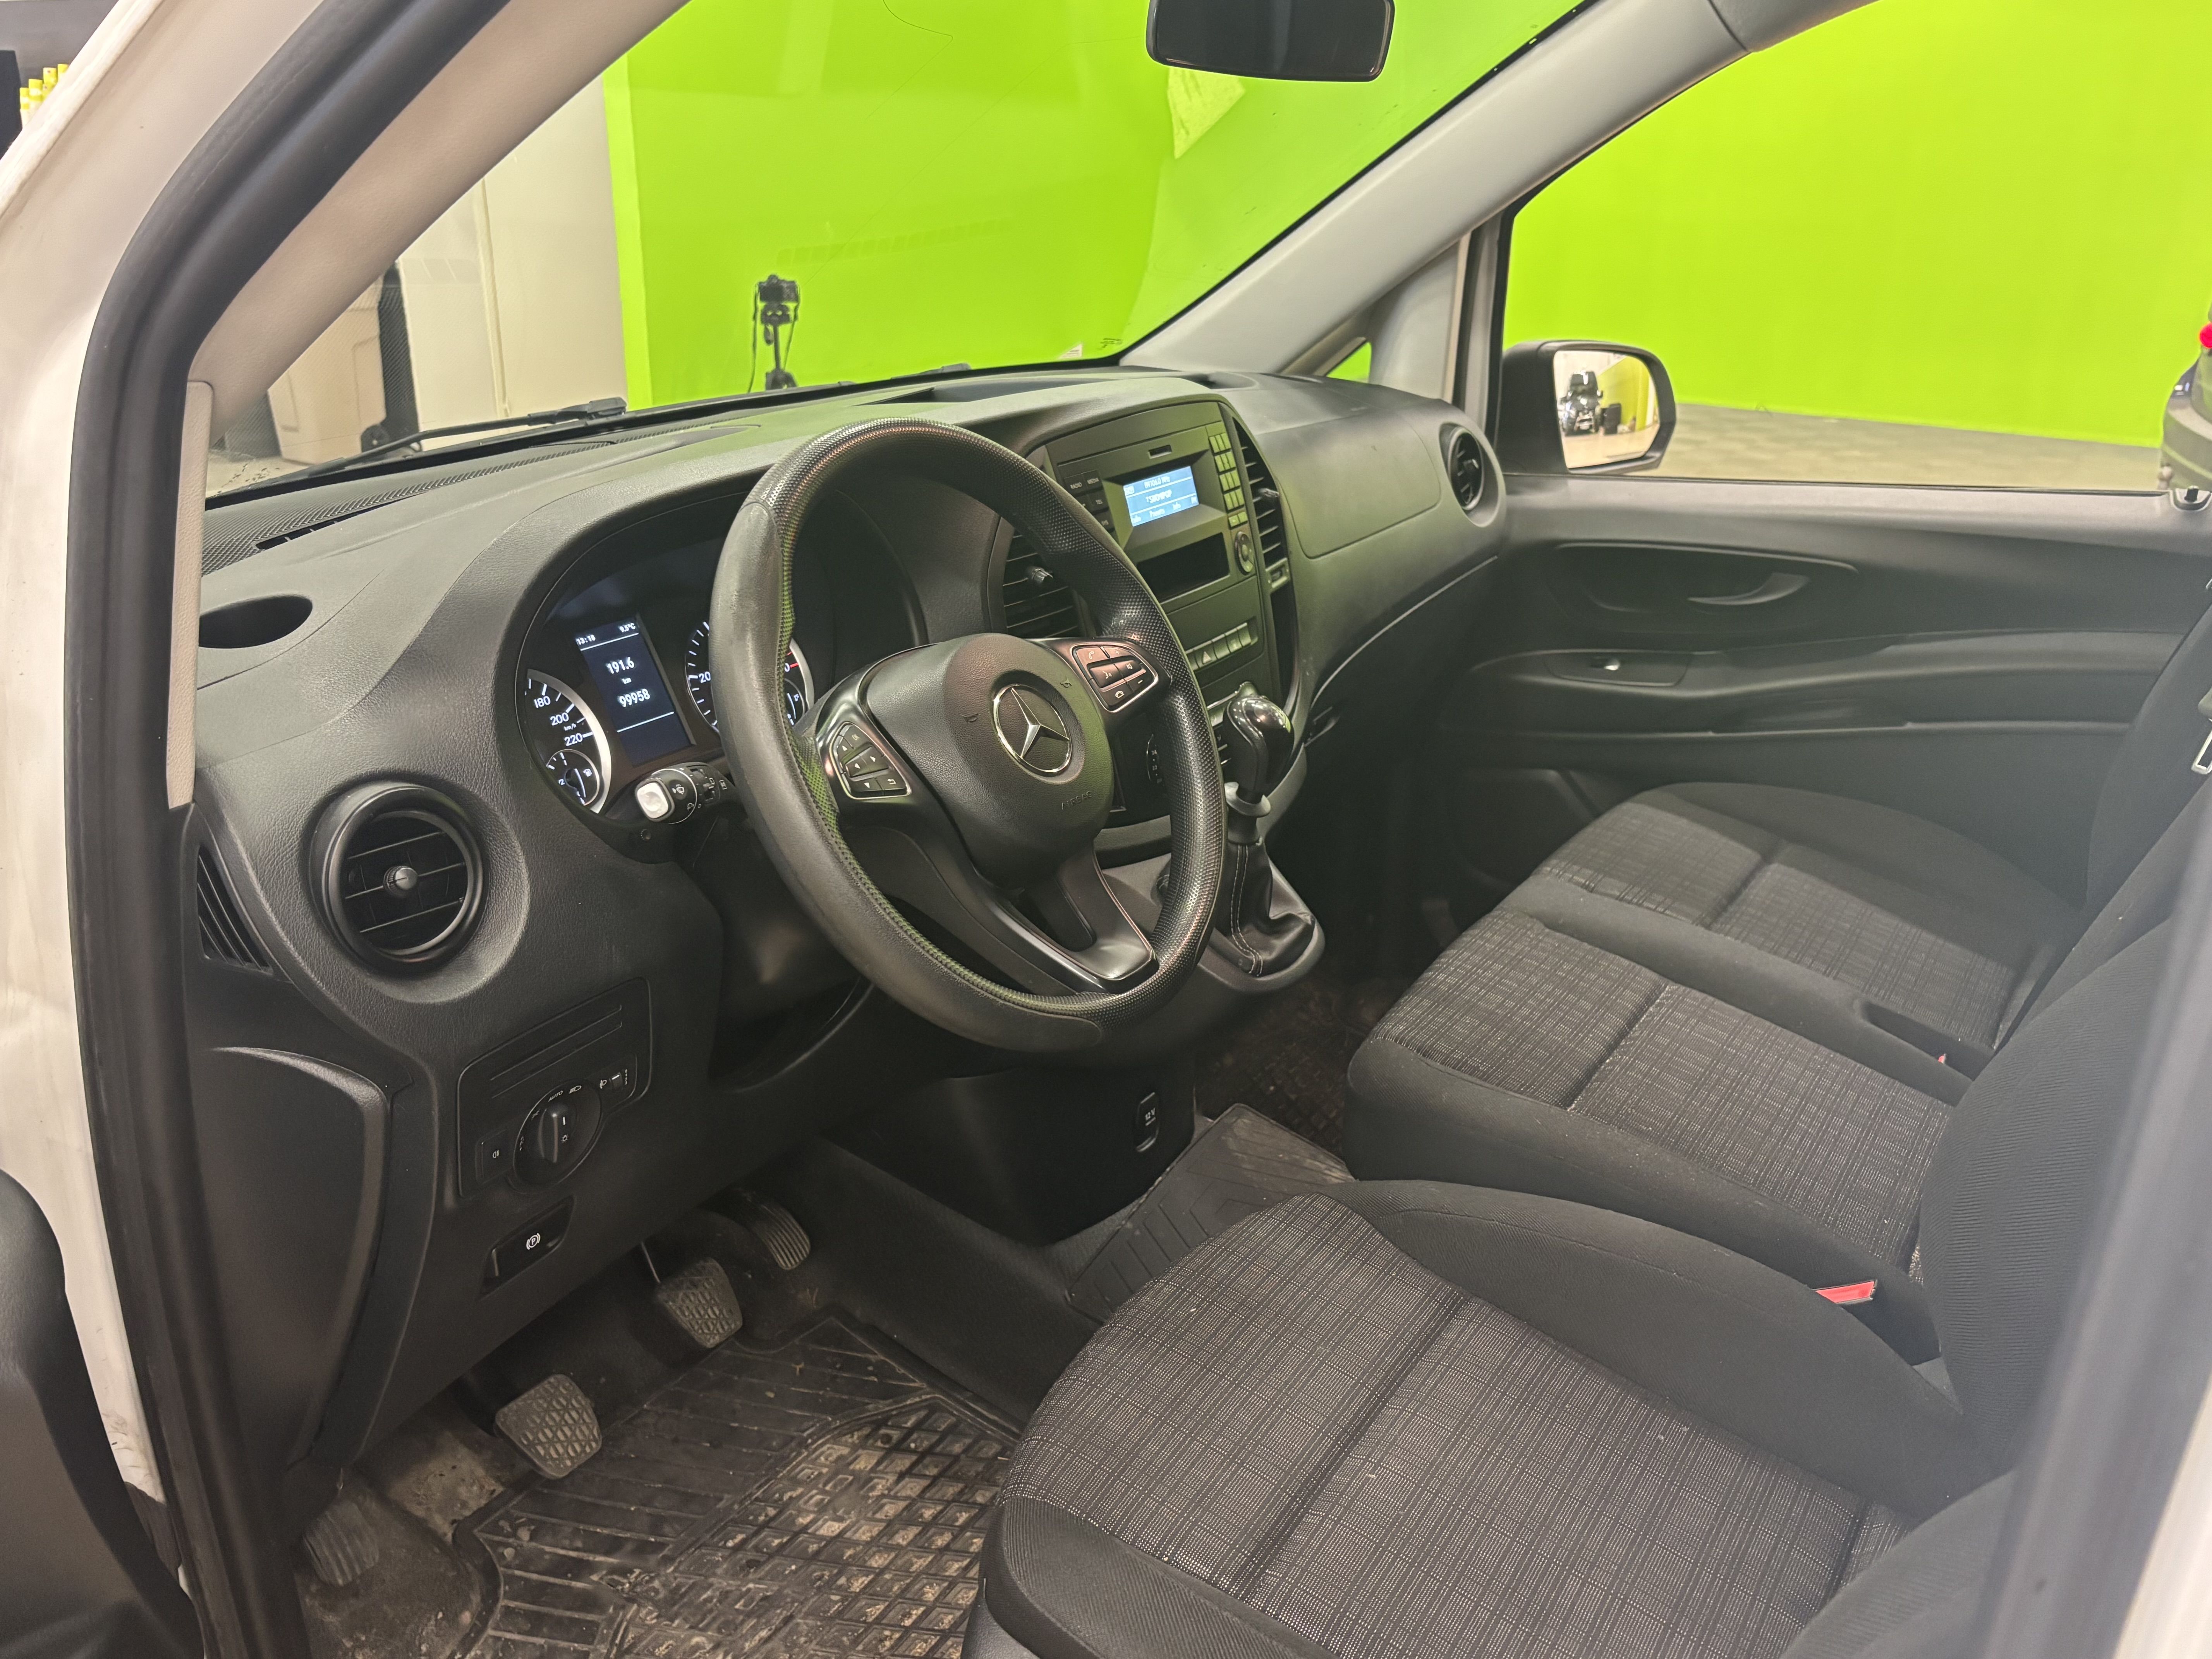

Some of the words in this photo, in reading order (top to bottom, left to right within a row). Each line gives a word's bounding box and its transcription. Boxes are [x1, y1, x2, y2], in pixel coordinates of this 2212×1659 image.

[606, 656, 635, 674] 191.6
[699, 671, 711, 684] 20
[534, 696, 551, 708] 180
[619, 689, 650, 708] 99958
[550, 712, 569, 726] 200
[564, 723, 577, 731] km/h
[564, 733, 583, 747] 220
[548, 1090, 563, 1102] AUTO
